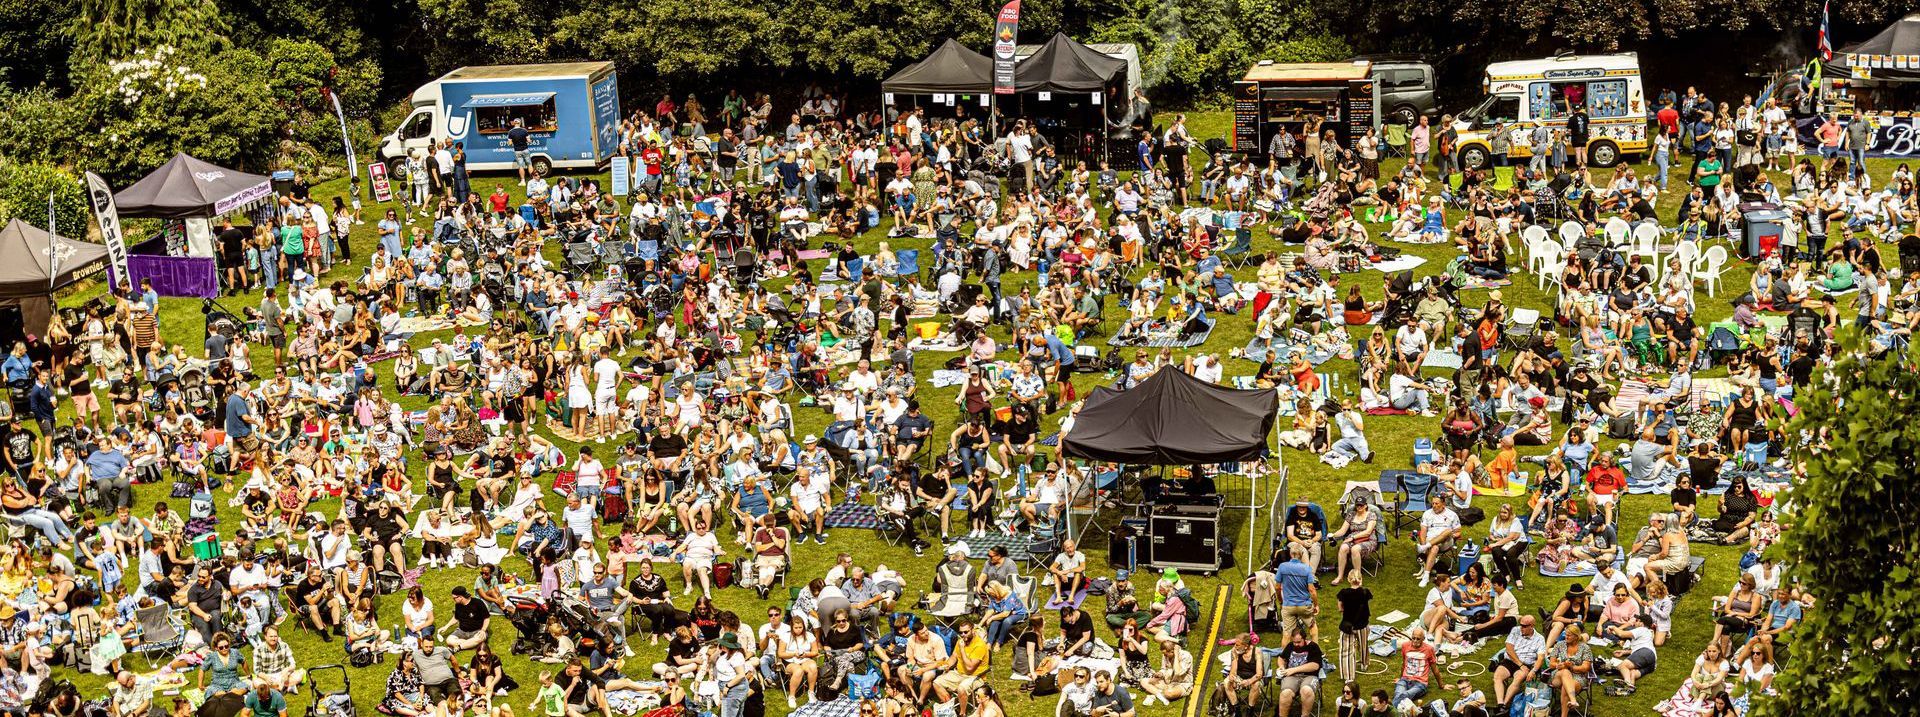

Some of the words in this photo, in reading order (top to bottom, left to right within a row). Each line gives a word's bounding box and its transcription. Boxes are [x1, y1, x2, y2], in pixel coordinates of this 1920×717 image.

[1496, 83, 1510, 92] CANDY
[102, 216, 127, 279] CHINA
[72, 260, 105, 281] Brownies
[103, 560, 115, 572] 13
